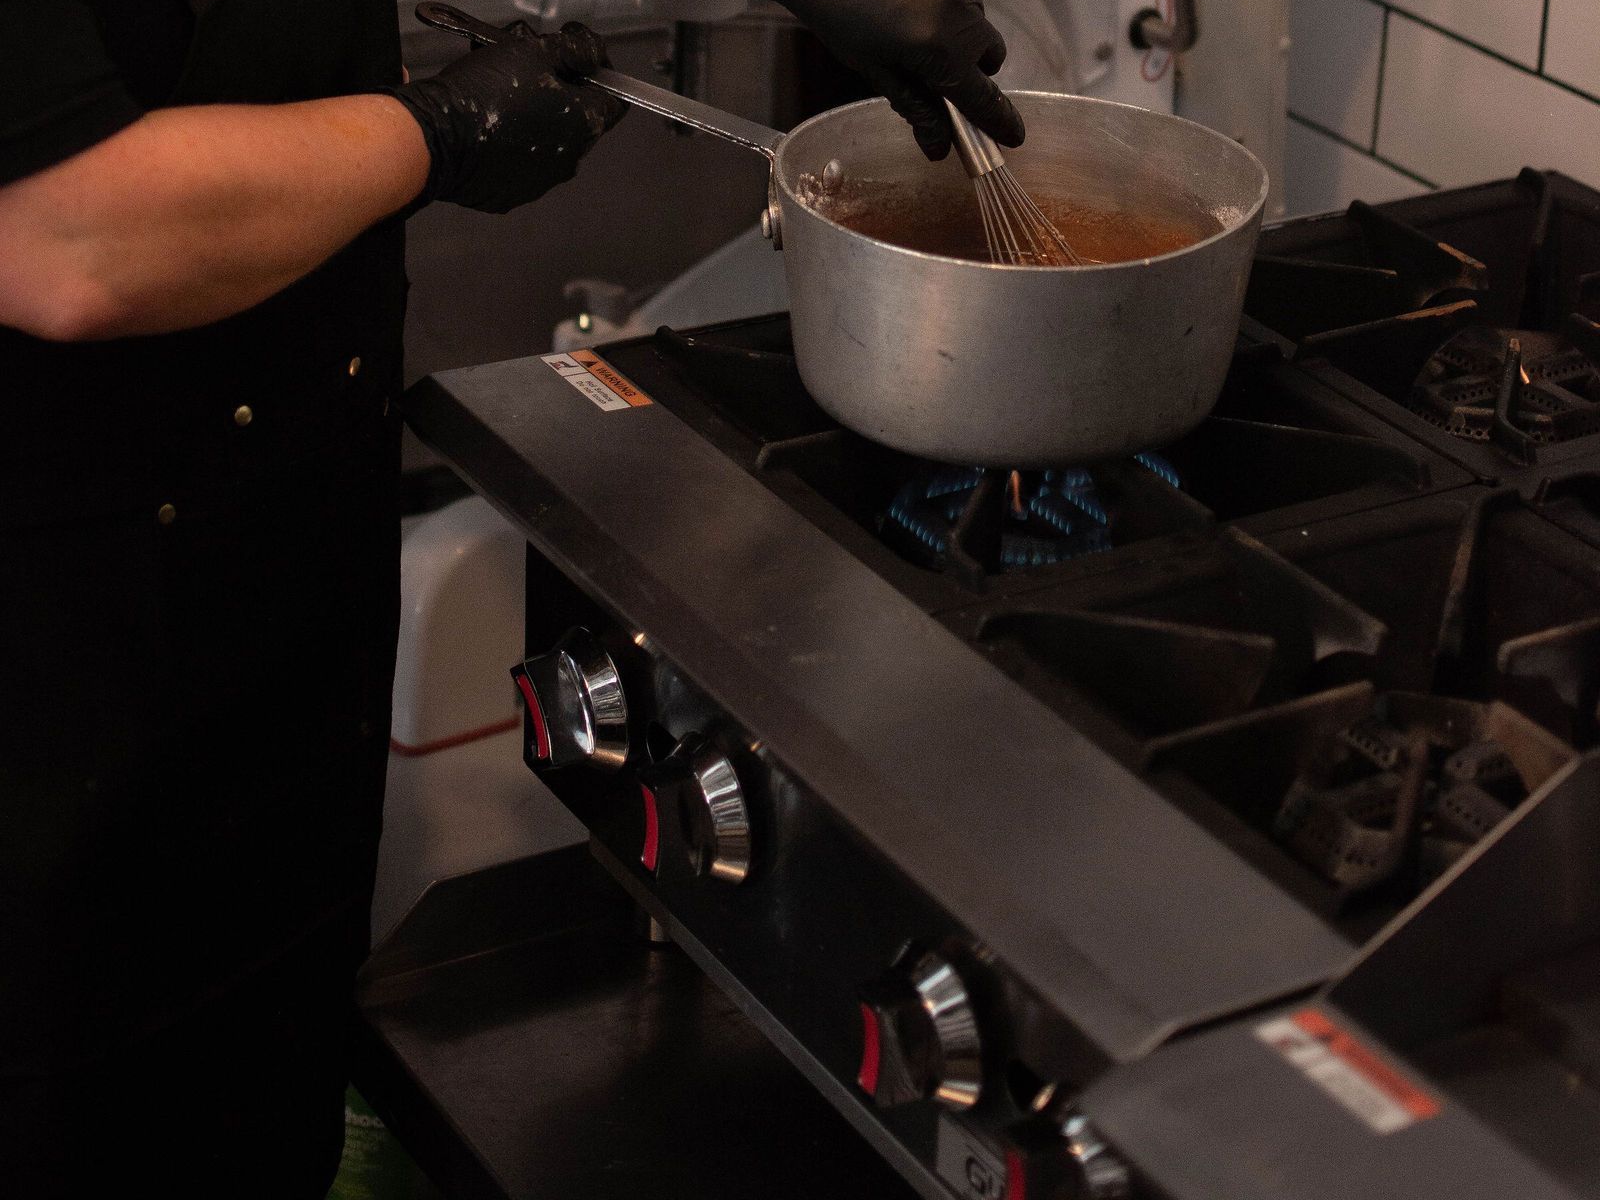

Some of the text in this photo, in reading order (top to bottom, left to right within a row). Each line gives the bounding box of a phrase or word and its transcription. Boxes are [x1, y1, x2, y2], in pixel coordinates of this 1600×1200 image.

[585, 380, 614, 402] Hot Surface
[596, 367, 636, 397] WARNING
